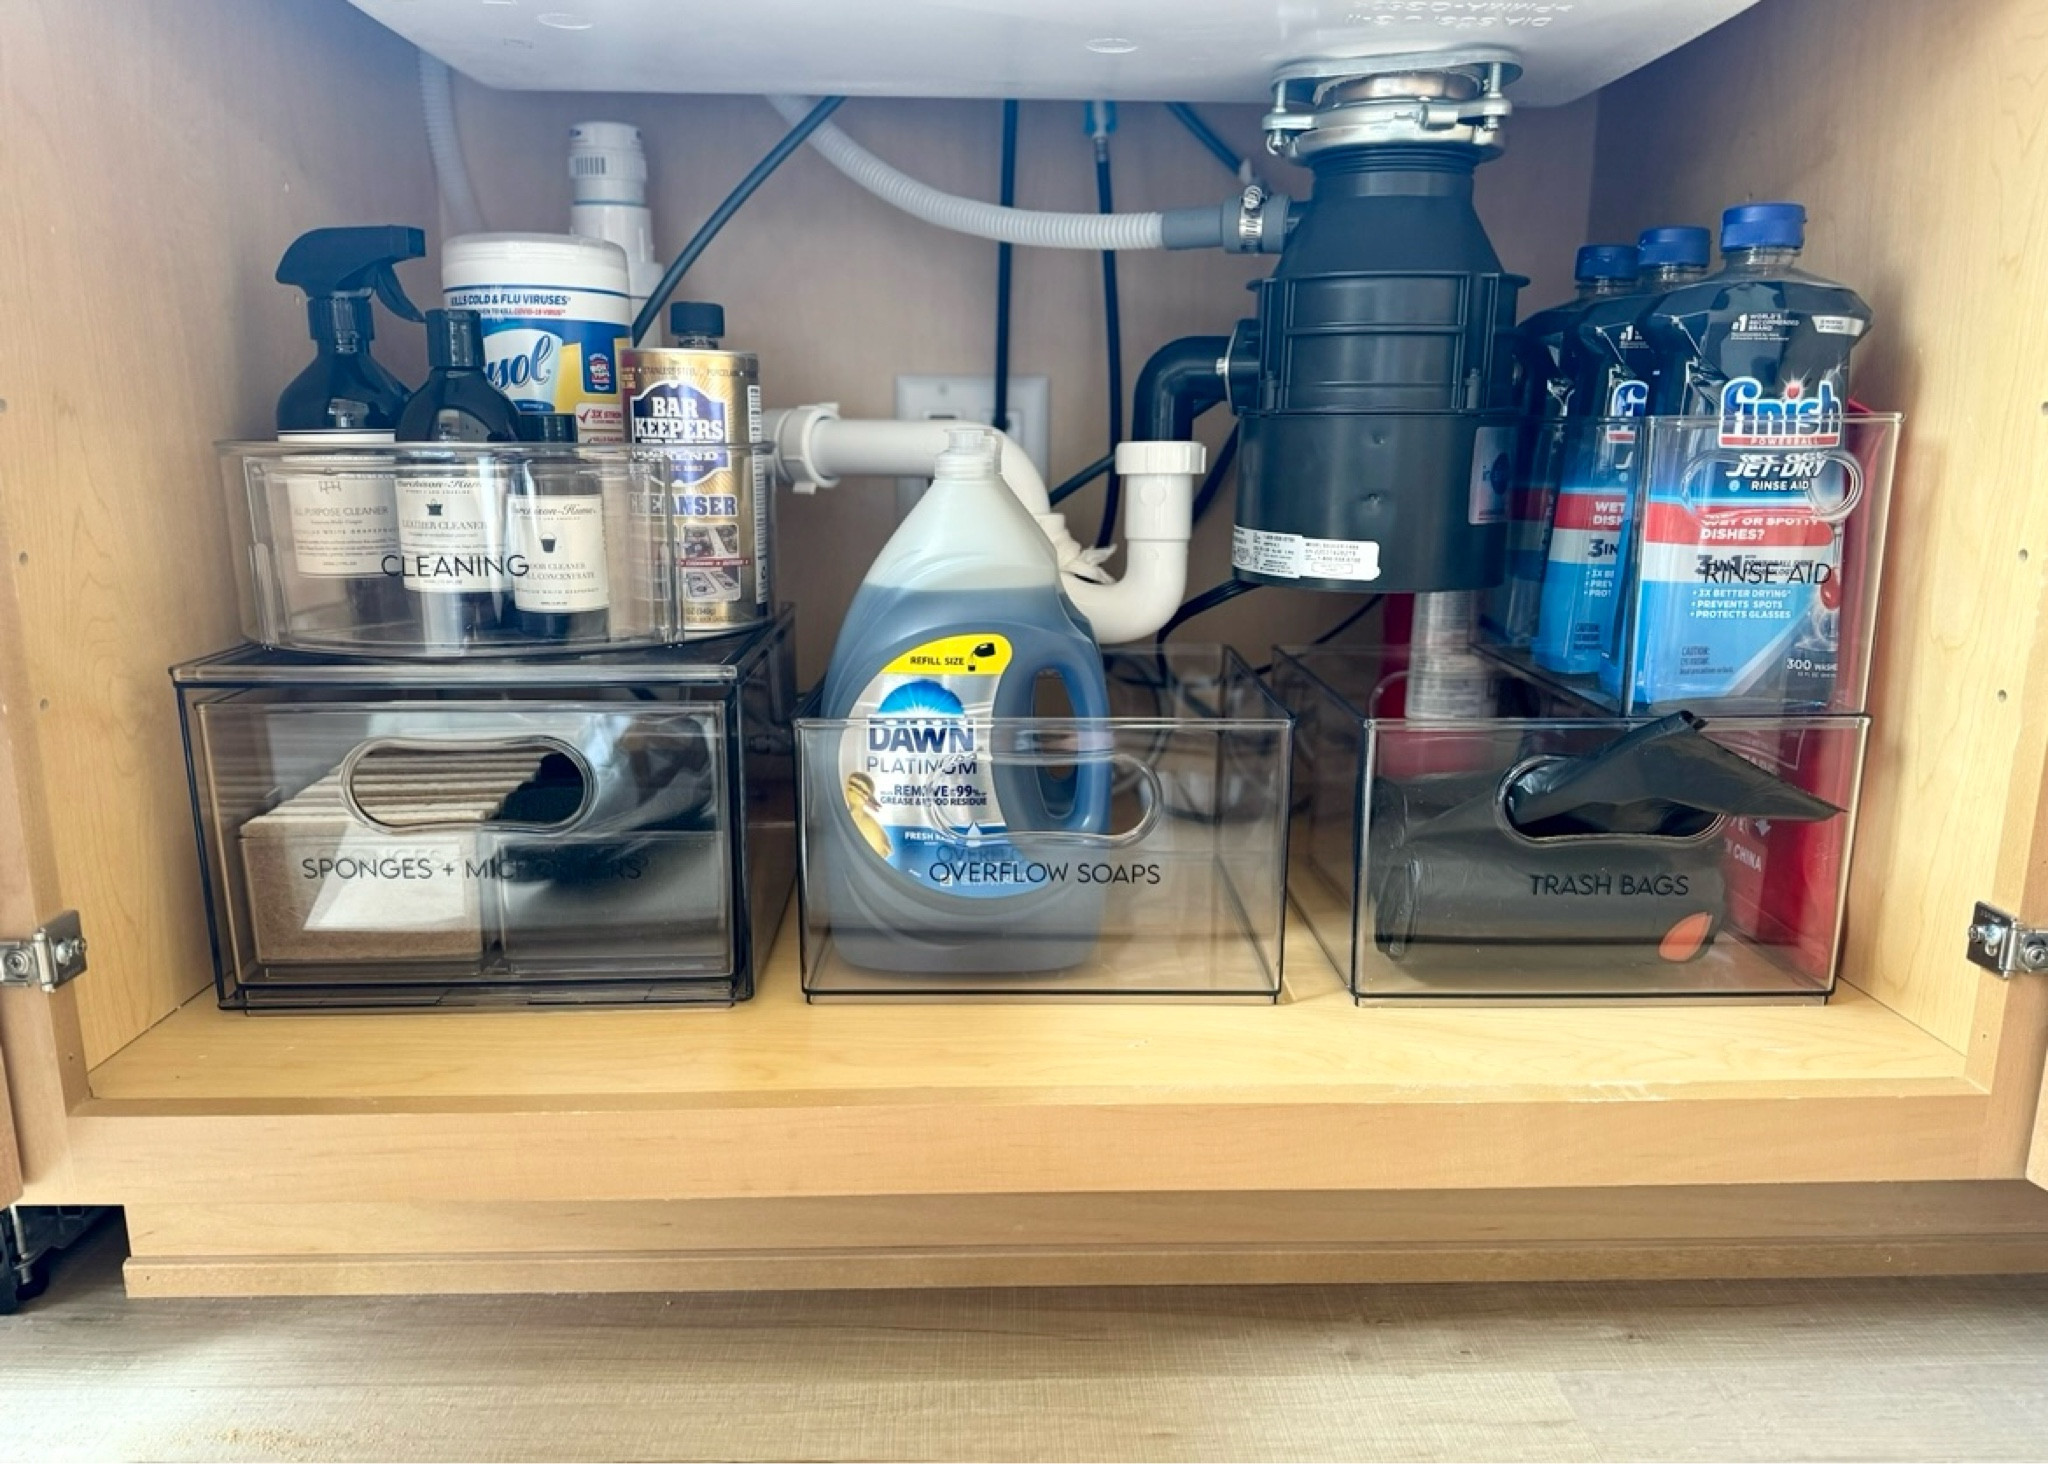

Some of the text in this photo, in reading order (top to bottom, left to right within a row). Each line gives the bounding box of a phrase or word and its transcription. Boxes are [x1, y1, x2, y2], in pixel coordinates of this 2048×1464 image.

[469, 294, 490, 306] COLD
[491, 295, 499, 304] &
[501, 294, 520, 305] FLU
[651, 396, 699, 418] BAR
[1720, 376, 1842, 436] finish
[634, 417, 724, 440] KEEPERS
[1750, 436, 1820, 446] POWERBALL
[1726, 452, 1828, 478] JET-DRY
[1751, 480, 1810, 491] RINSE AID
[1741, 516, 1764, 526] OR
[1700, 528, 1766, 541] DISHES?
[381, 554, 530, 578] CLEANING
[1703, 563, 1778, 584] RINSE
[1786, 563, 1833, 584] AID
[1713, 589, 1750, 598] BETTER
[1697, 600, 1783, 609] PREVENTS SPOTS
[1695, 610, 1791, 619] PROTECTS GLASSES
[910, 656, 965, 666] REFILL SIZE
[1787, 658, 1811, 670] 300
[868, 718, 975, 754] DAWN
[880, 796, 914, 806] GREASE
[950, 797, 988, 806] RESIDUE
[904, 831, 935, 841] FRESH
[302, 858, 433, 880] SPONGES
[928, 861, 1069, 885] OVERFLOW
[1076, 863, 1161, 886] SOAPS
[1530, 874, 1690, 897] TRASH BAGS
